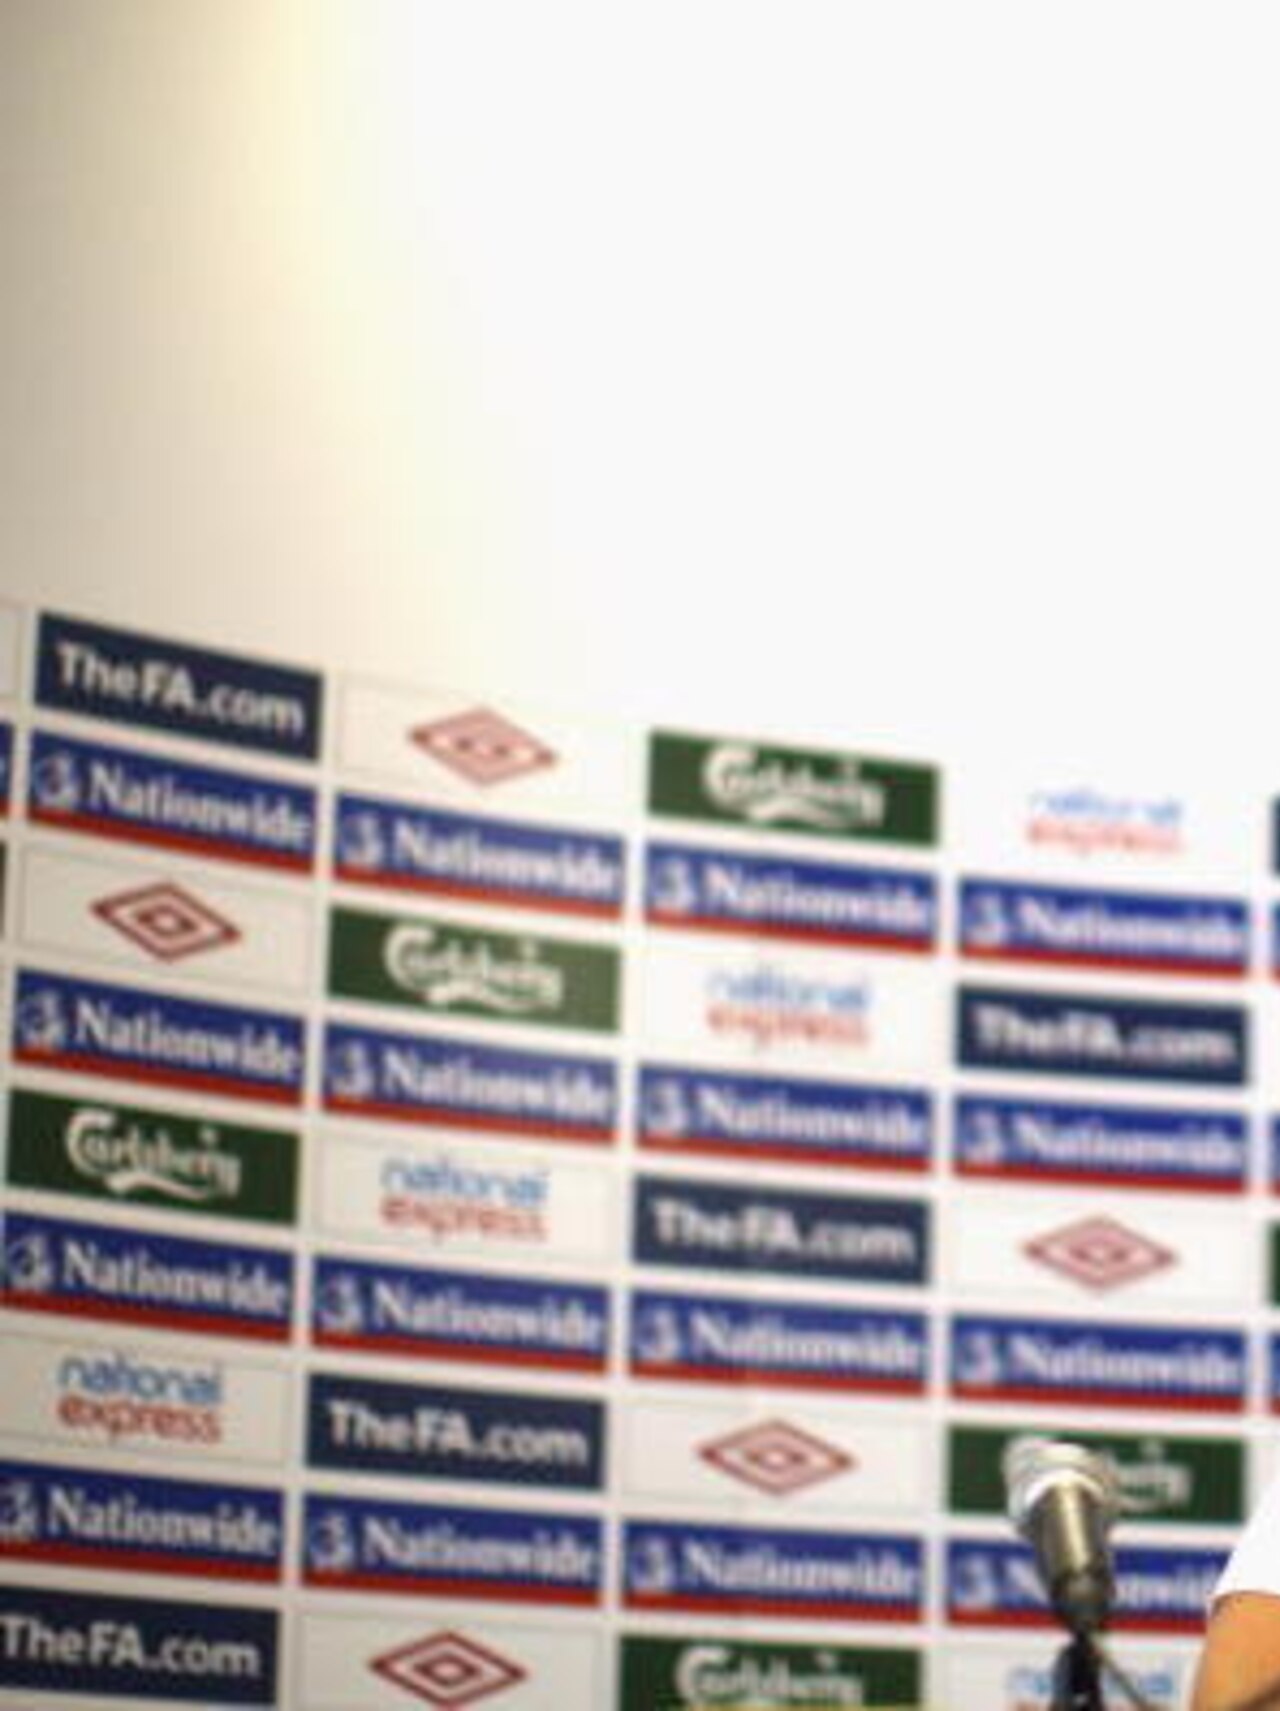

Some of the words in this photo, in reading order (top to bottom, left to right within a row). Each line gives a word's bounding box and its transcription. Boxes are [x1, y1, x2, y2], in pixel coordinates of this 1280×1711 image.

[91, 764, 310, 849] Nationwide
[706, 744, 887, 827] Carlsberg
[1028, 787, 1182, 826] national
[394, 818, 620, 893] Nationwide
[1025, 817, 1184, 857] express
[707, 857, 933, 932] Nationwide
[1016, 893, 1245, 955] Nationwide
[384, 922, 564, 1010] Carlsberg
[708, 966, 868, 1012] national
[75, 1001, 300, 1080] Nationwide
[706, 1005, 869, 1050] express
[387, 1051, 614, 1120] Nationwide
[702, 1082, 929, 1155] Nationwide
[1010, 1112, 1245, 1171] Nationwide
[66, 1106, 241, 1198] Carlsberg
[381, 1158, 548, 1206] national
[380, 1196, 548, 1243] express
[62, 1241, 286, 1318] Nationwide
[372, 1283, 606, 1351] Nationwide
[690, 1308, 922, 1377] Nationwide
[56, 1353, 220, 1404] national
[1010, 1333, 1244, 1391] Nationwide
[56, 1396, 221, 1445] express
[47, 1493, 277, 1558] Nationwide
[363, 1516, 595, 1581] Nationwide
[686, 1539, 919, 1602] Nationwide
